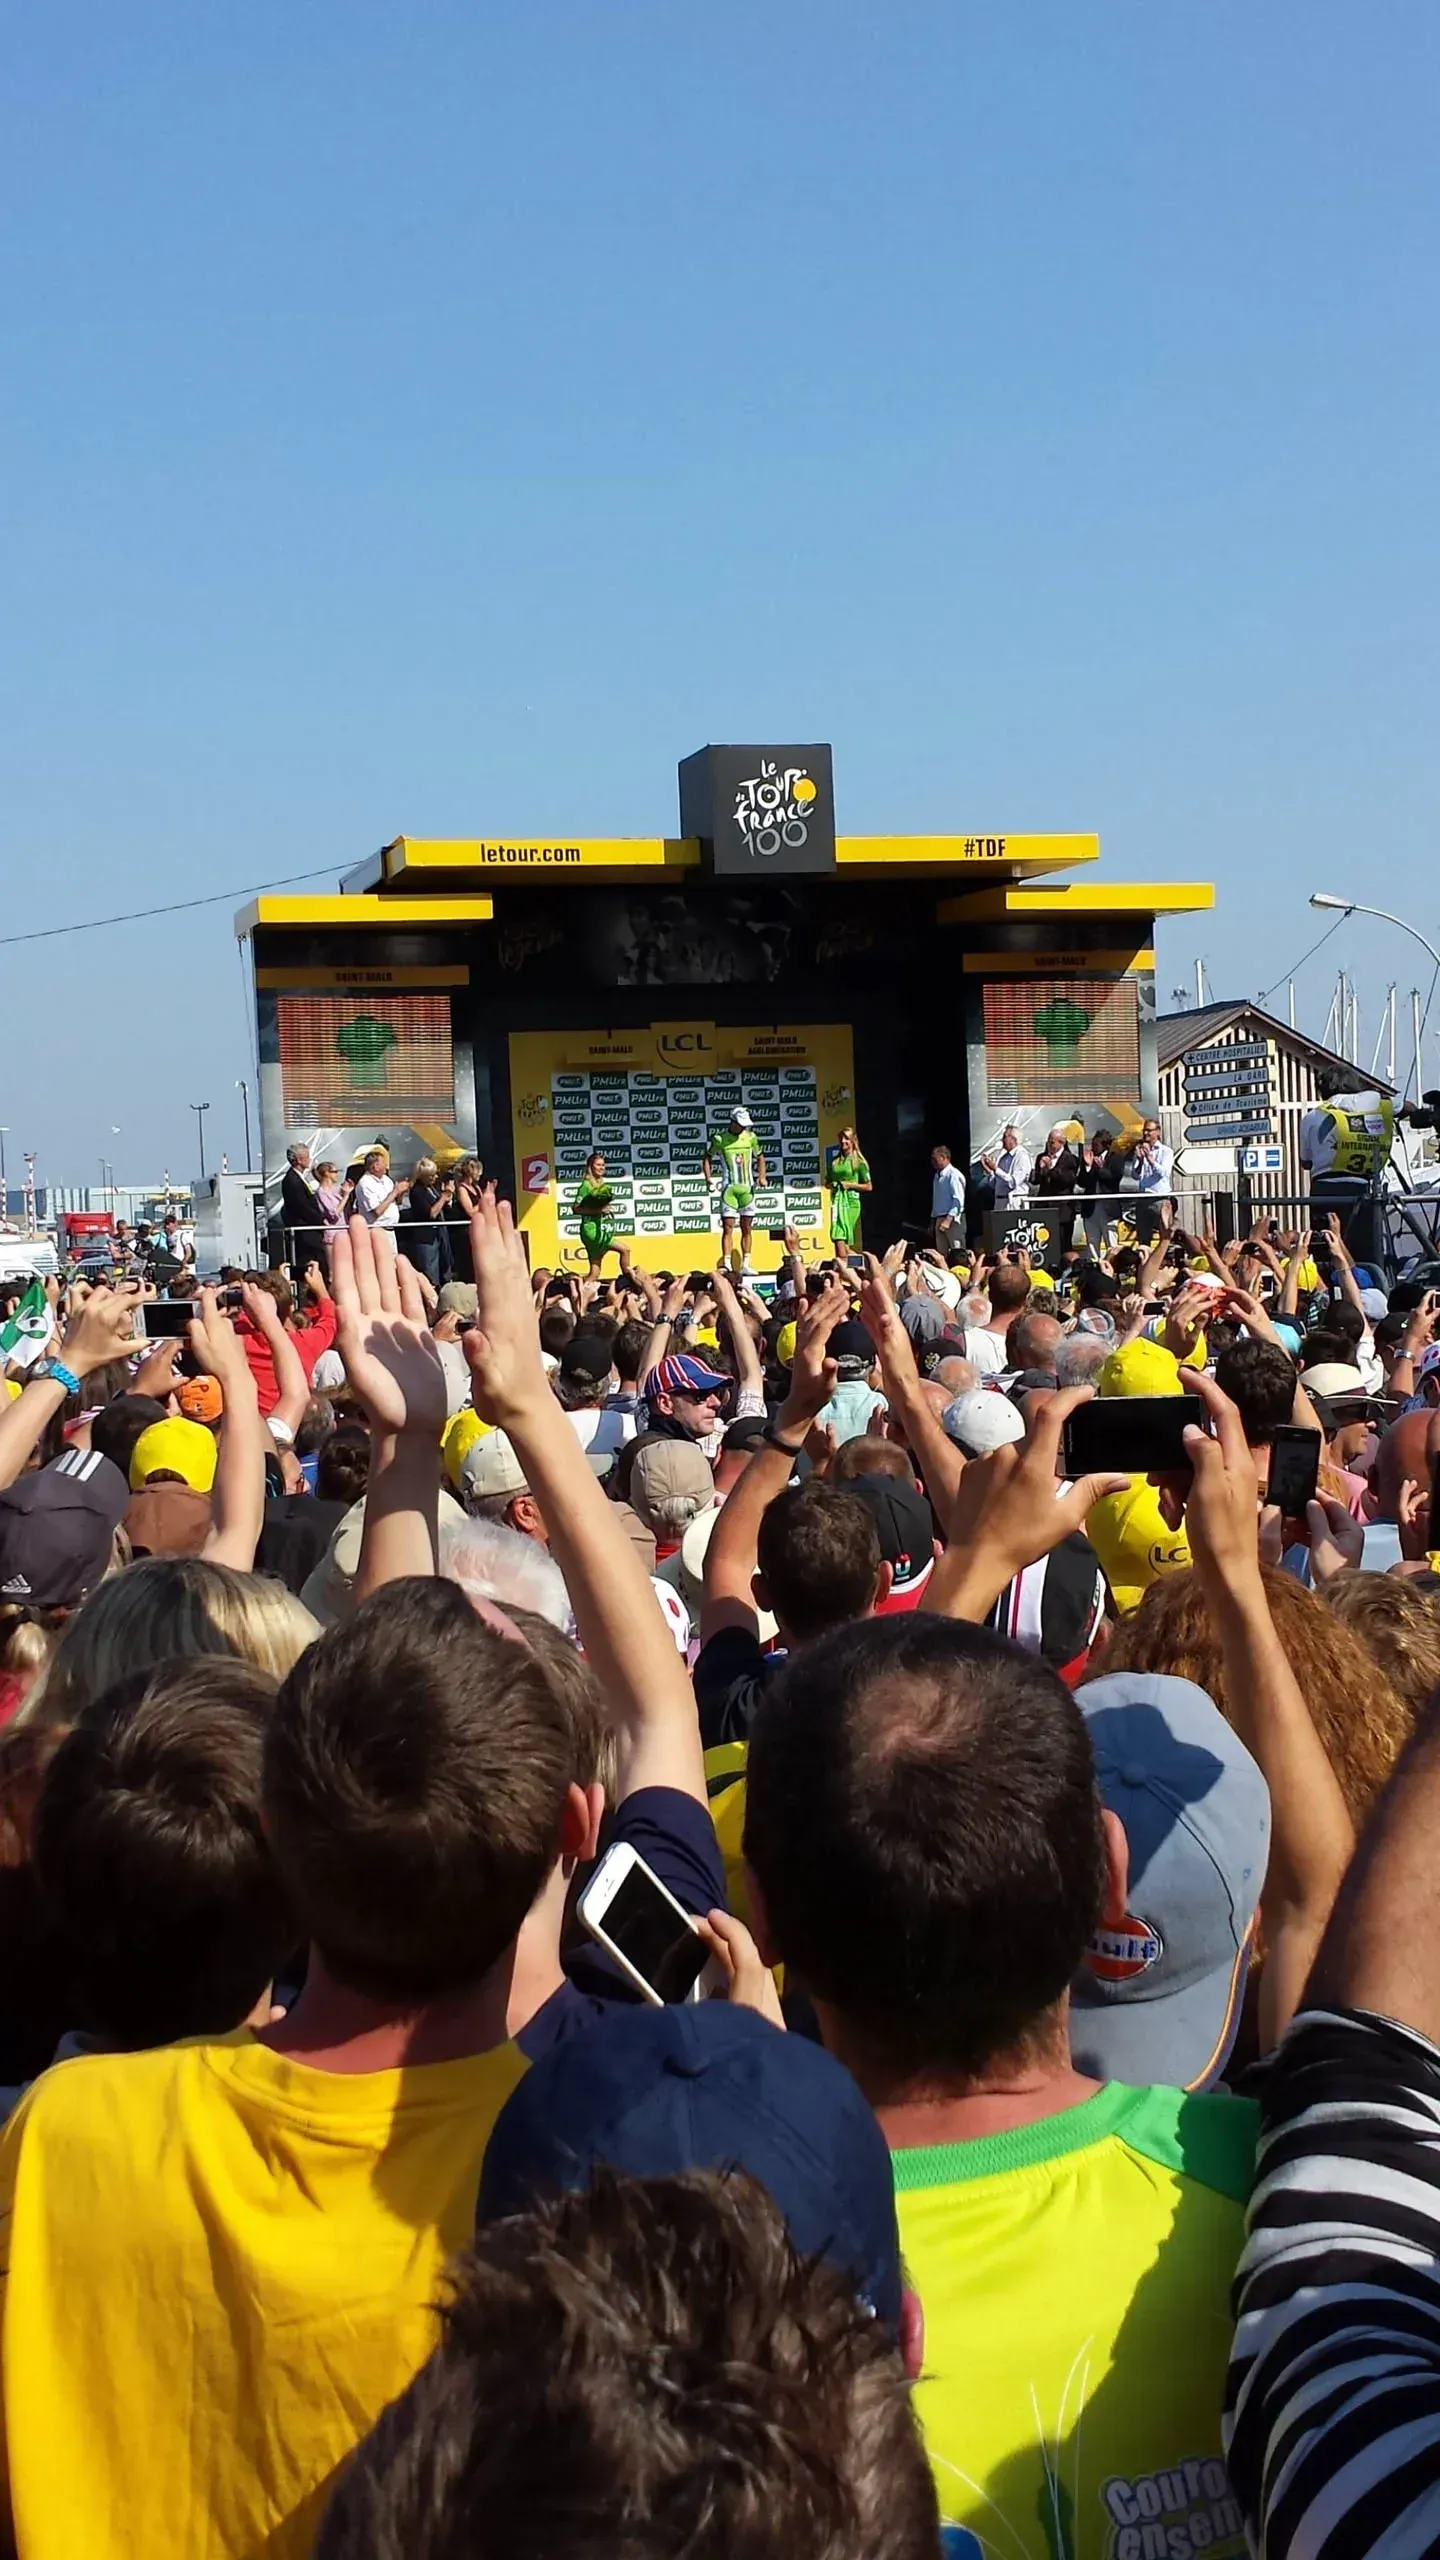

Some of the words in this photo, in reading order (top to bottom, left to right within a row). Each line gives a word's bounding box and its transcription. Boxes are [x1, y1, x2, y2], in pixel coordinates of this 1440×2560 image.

[741, 820, 809, 857] 100
[480, 843, 581, 862] letour.com
[963, 838, 1006, 857] #TDF
[661, 1034, 713, 1051] LCL
[1195, 1050, 1221, 1061] CENTRE
[1223, 1044, 1265, 1059] HOSPITALIER
[1234, 1073, 1242, 1082] LA
[1247, 1069, 1267, 1081] GARE
[1198, 1102, 1219, 1113] Office
[1223, 1101, 1231, 1110] de
[1236, 1098, 1268, 1109] Tourisme
[1246, 1152, 1257, 1167] P
[528, 1160, 549, 1189] 2
[798, 1237, 825, 1251] CL
[563, 1247, 589, 1261] LC
[1154, 1545, 1188, 1563] LC
[1105, 2460, 1227, 2526] Couro
[1117, 2499, 1244, 2560] ensem
